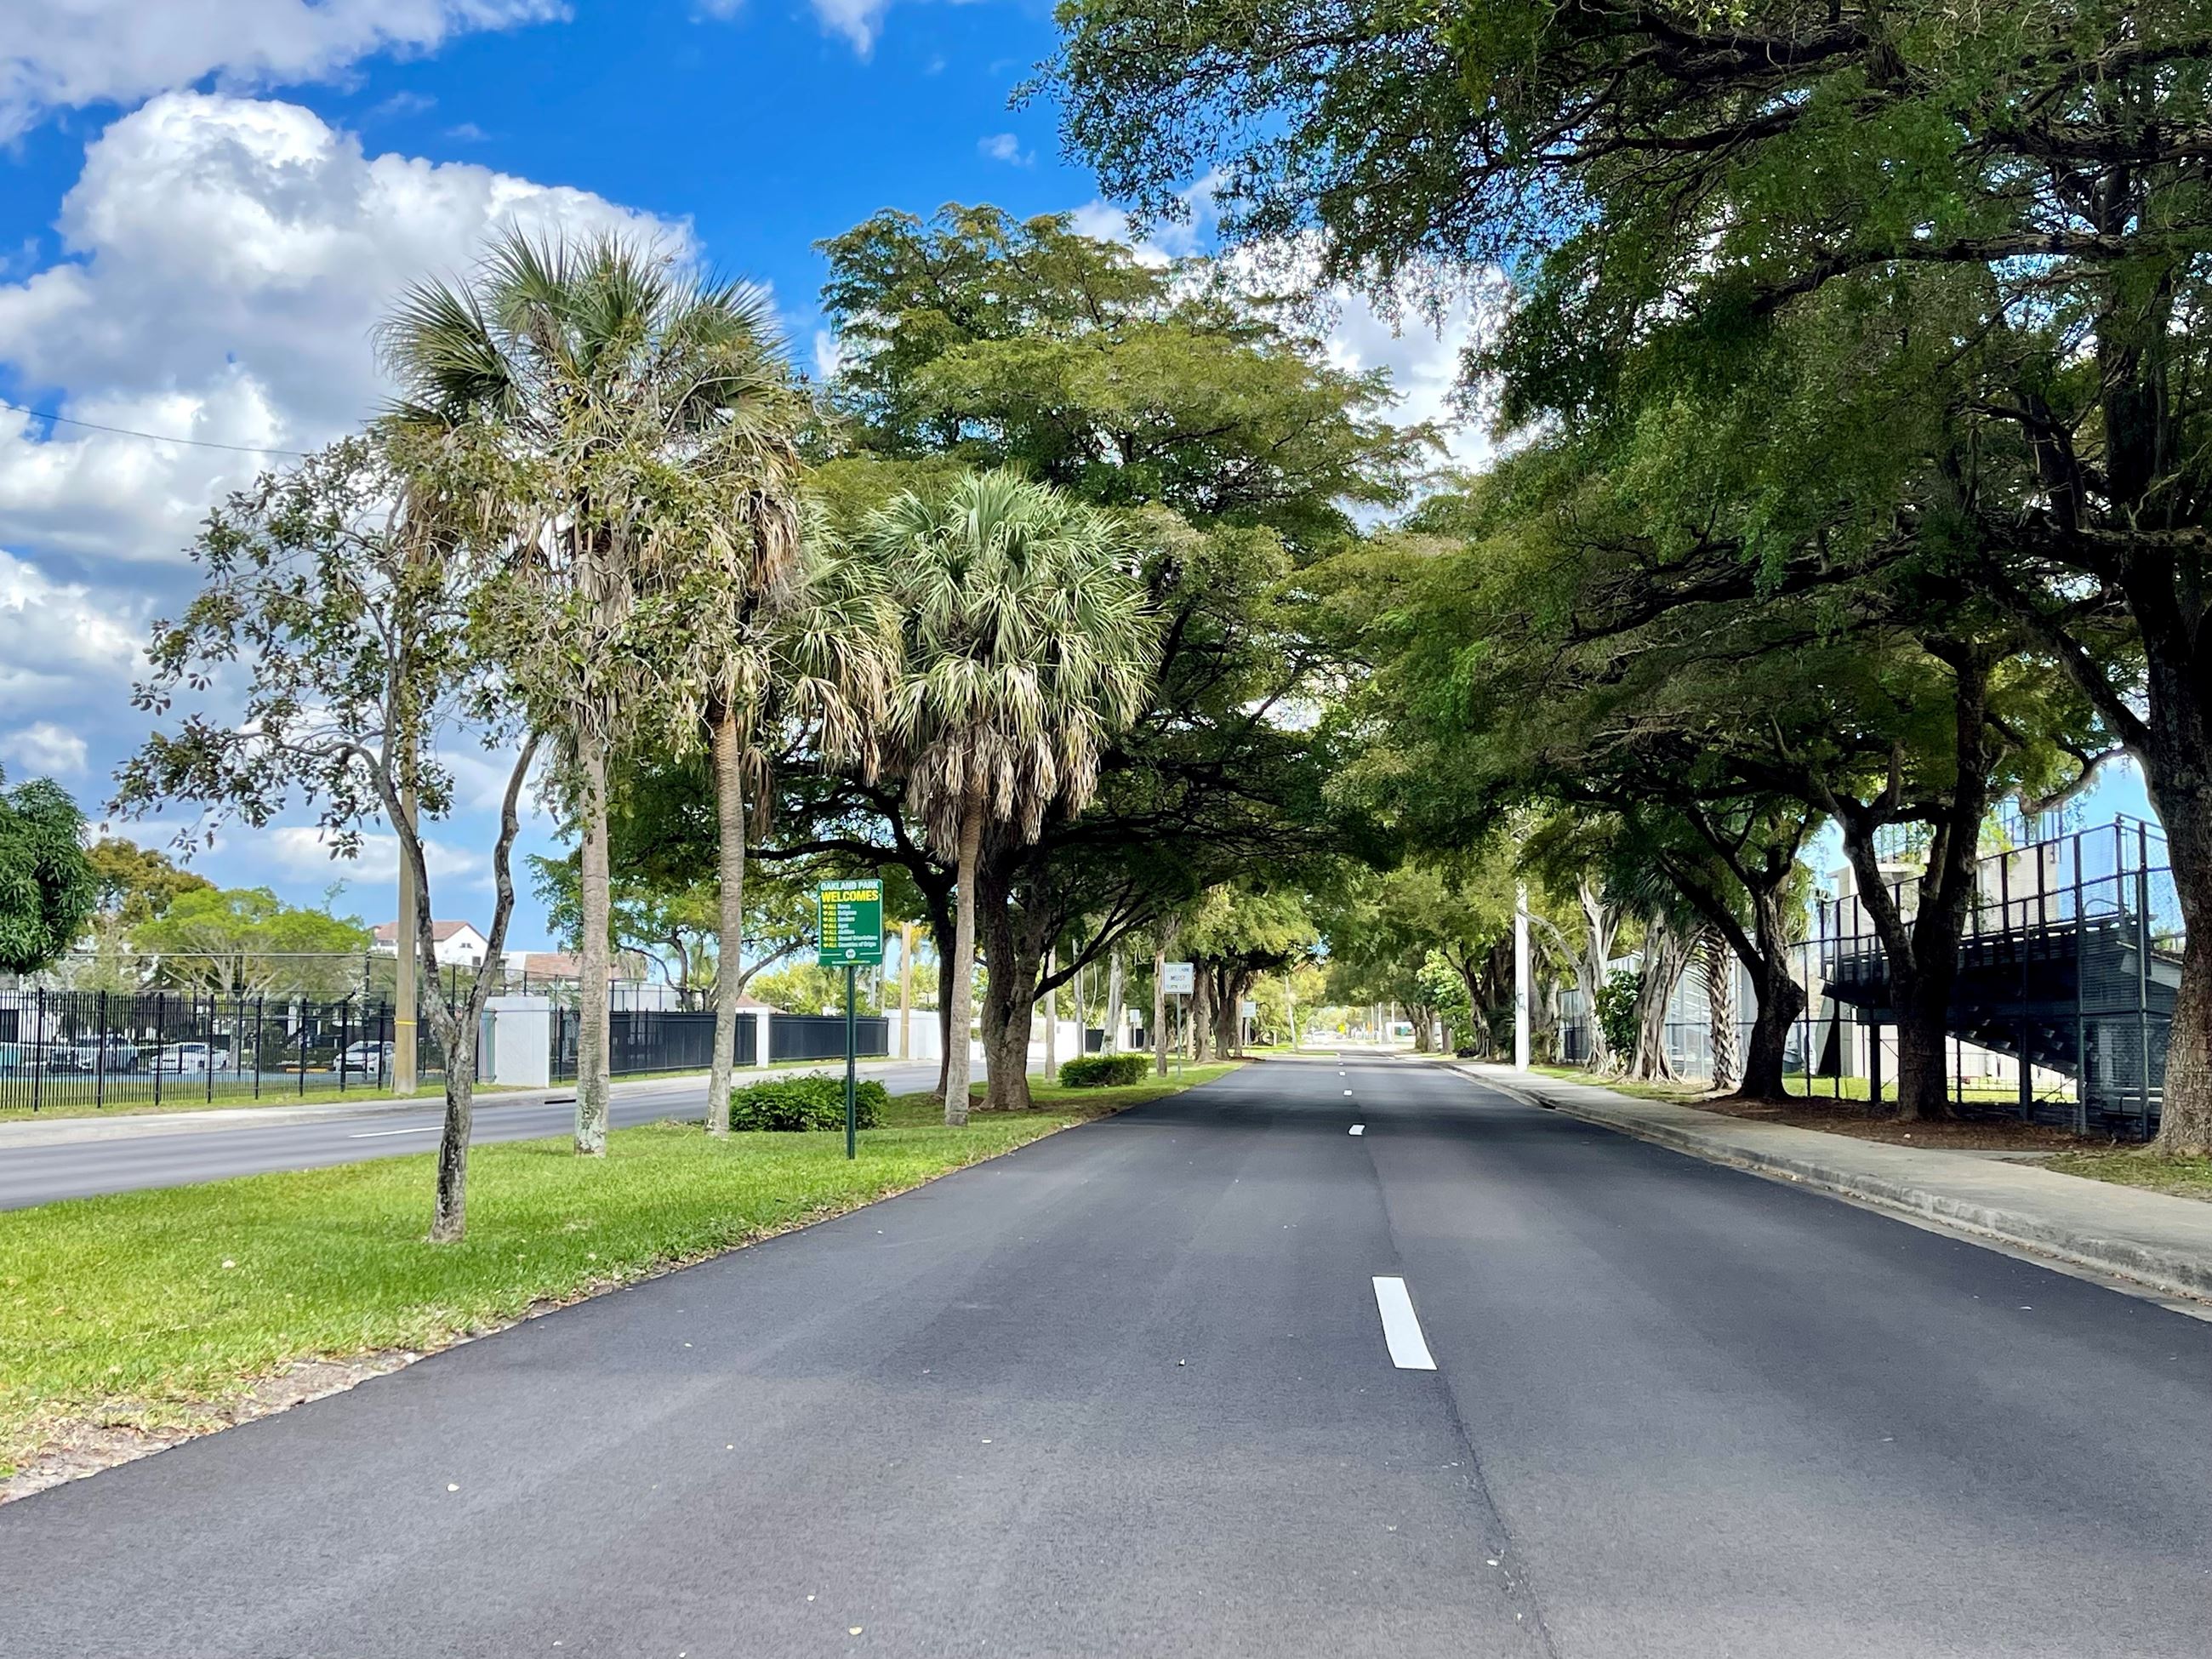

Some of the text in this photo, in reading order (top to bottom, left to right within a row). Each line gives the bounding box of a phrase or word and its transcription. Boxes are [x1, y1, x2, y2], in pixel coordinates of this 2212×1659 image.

[820, 881, 879, 891] OAKLAND PARK
[821, 890, 879, 902] WELCOMES
